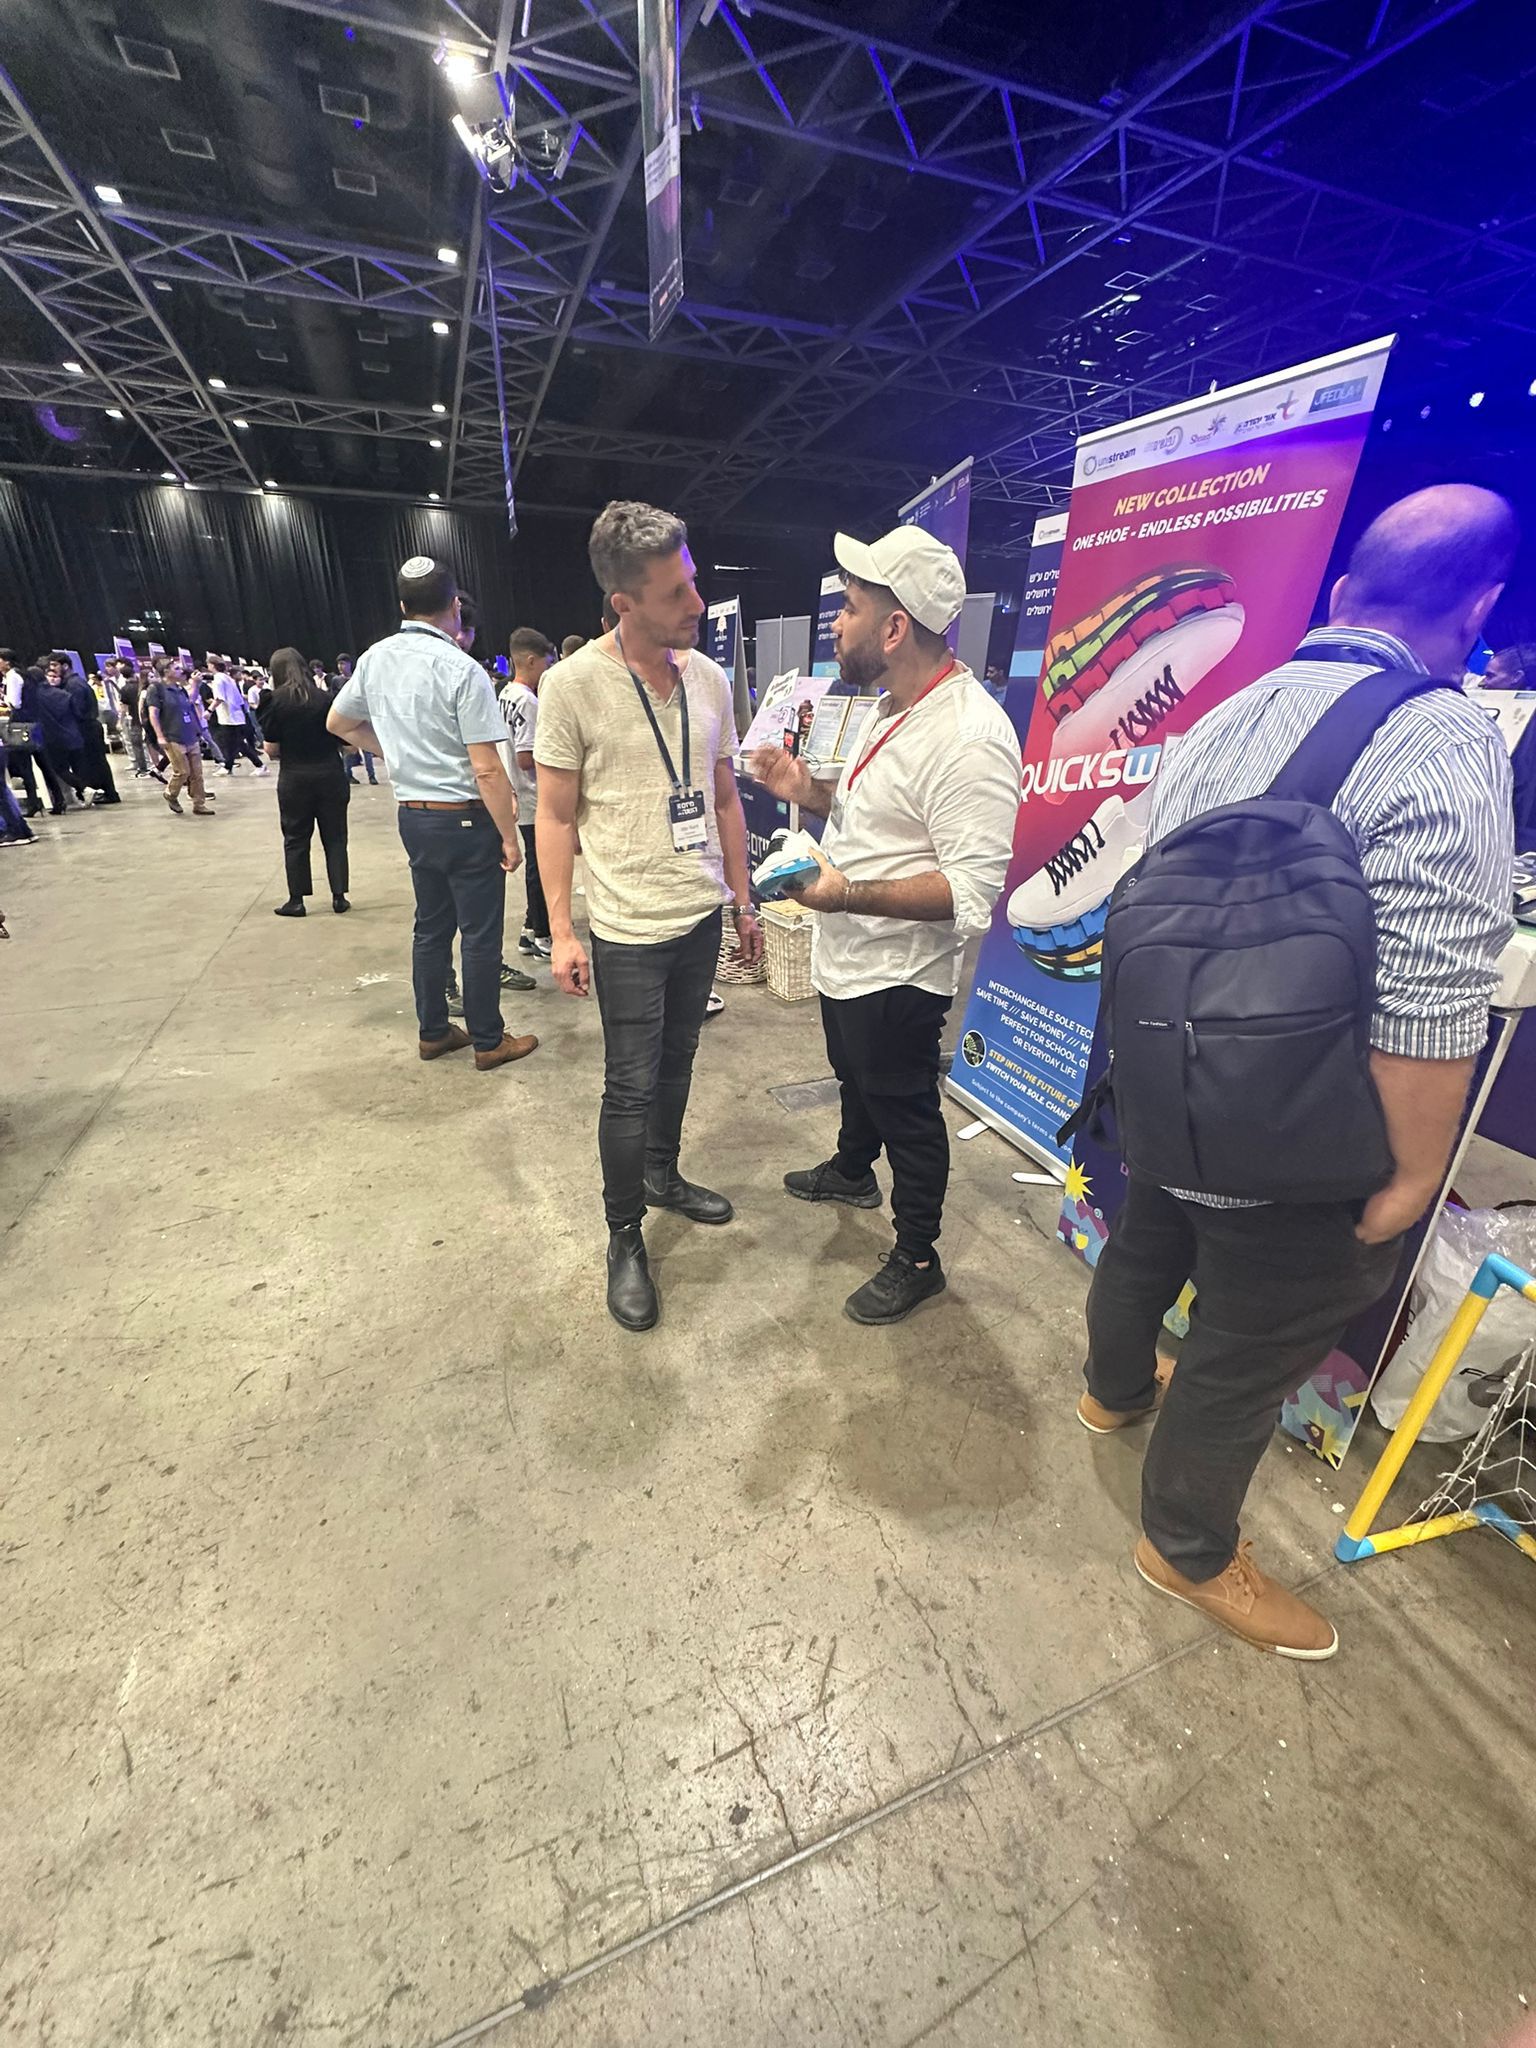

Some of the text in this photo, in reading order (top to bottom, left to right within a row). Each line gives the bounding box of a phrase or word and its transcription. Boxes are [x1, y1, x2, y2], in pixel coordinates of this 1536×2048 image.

[1098, 447, 1136, 467] unistream
[1113, 462, 1272, 517] NEW COLLECTION
[1072, 533, 1095, 552] ONE
[1095, 525, 1129, 547] SHOE
[1138, 512, 1201, 540] ENDLESS
[1202, 488, 1329, 528] POSSIBILITIES
[1020, 743, 1163, 803] QUICKSW
[975, 987, 992, 1003] SAVE
[992, 995, 1009, 1011] TIME
[1020, 1011, 1039, 1027] SAVE
[1038, 1020, 1067, 1041] MONEY
[988, 980, 1055, 1020] INTERCHANGEABLE
[1054, 1012, 1075, 1031] SOLE
[1000, 1014, 1030, 1036] PERFECT
[1029, 1030, 1047, 1044] FOR
[988, 1049, 1080, 1111] STEP INTO THE FUTURE OF
[1012, 1035, 1078, 1079] OR EVERYDAY LIFE
[971, 1078, 990, 1095] Subject
[989, 1091, 995, 1099] to
[994, 1096, 1004, 1105] the
[1004, 1102, 1032, 1125] company's
[1031, 1120, 1048, 1137] terms
[985, 1061, 1010, 1081] SWITCH
[1009, 1074, 1028, 1093] YOUR
[1045, 1101, 1071, 1121] CHANG
